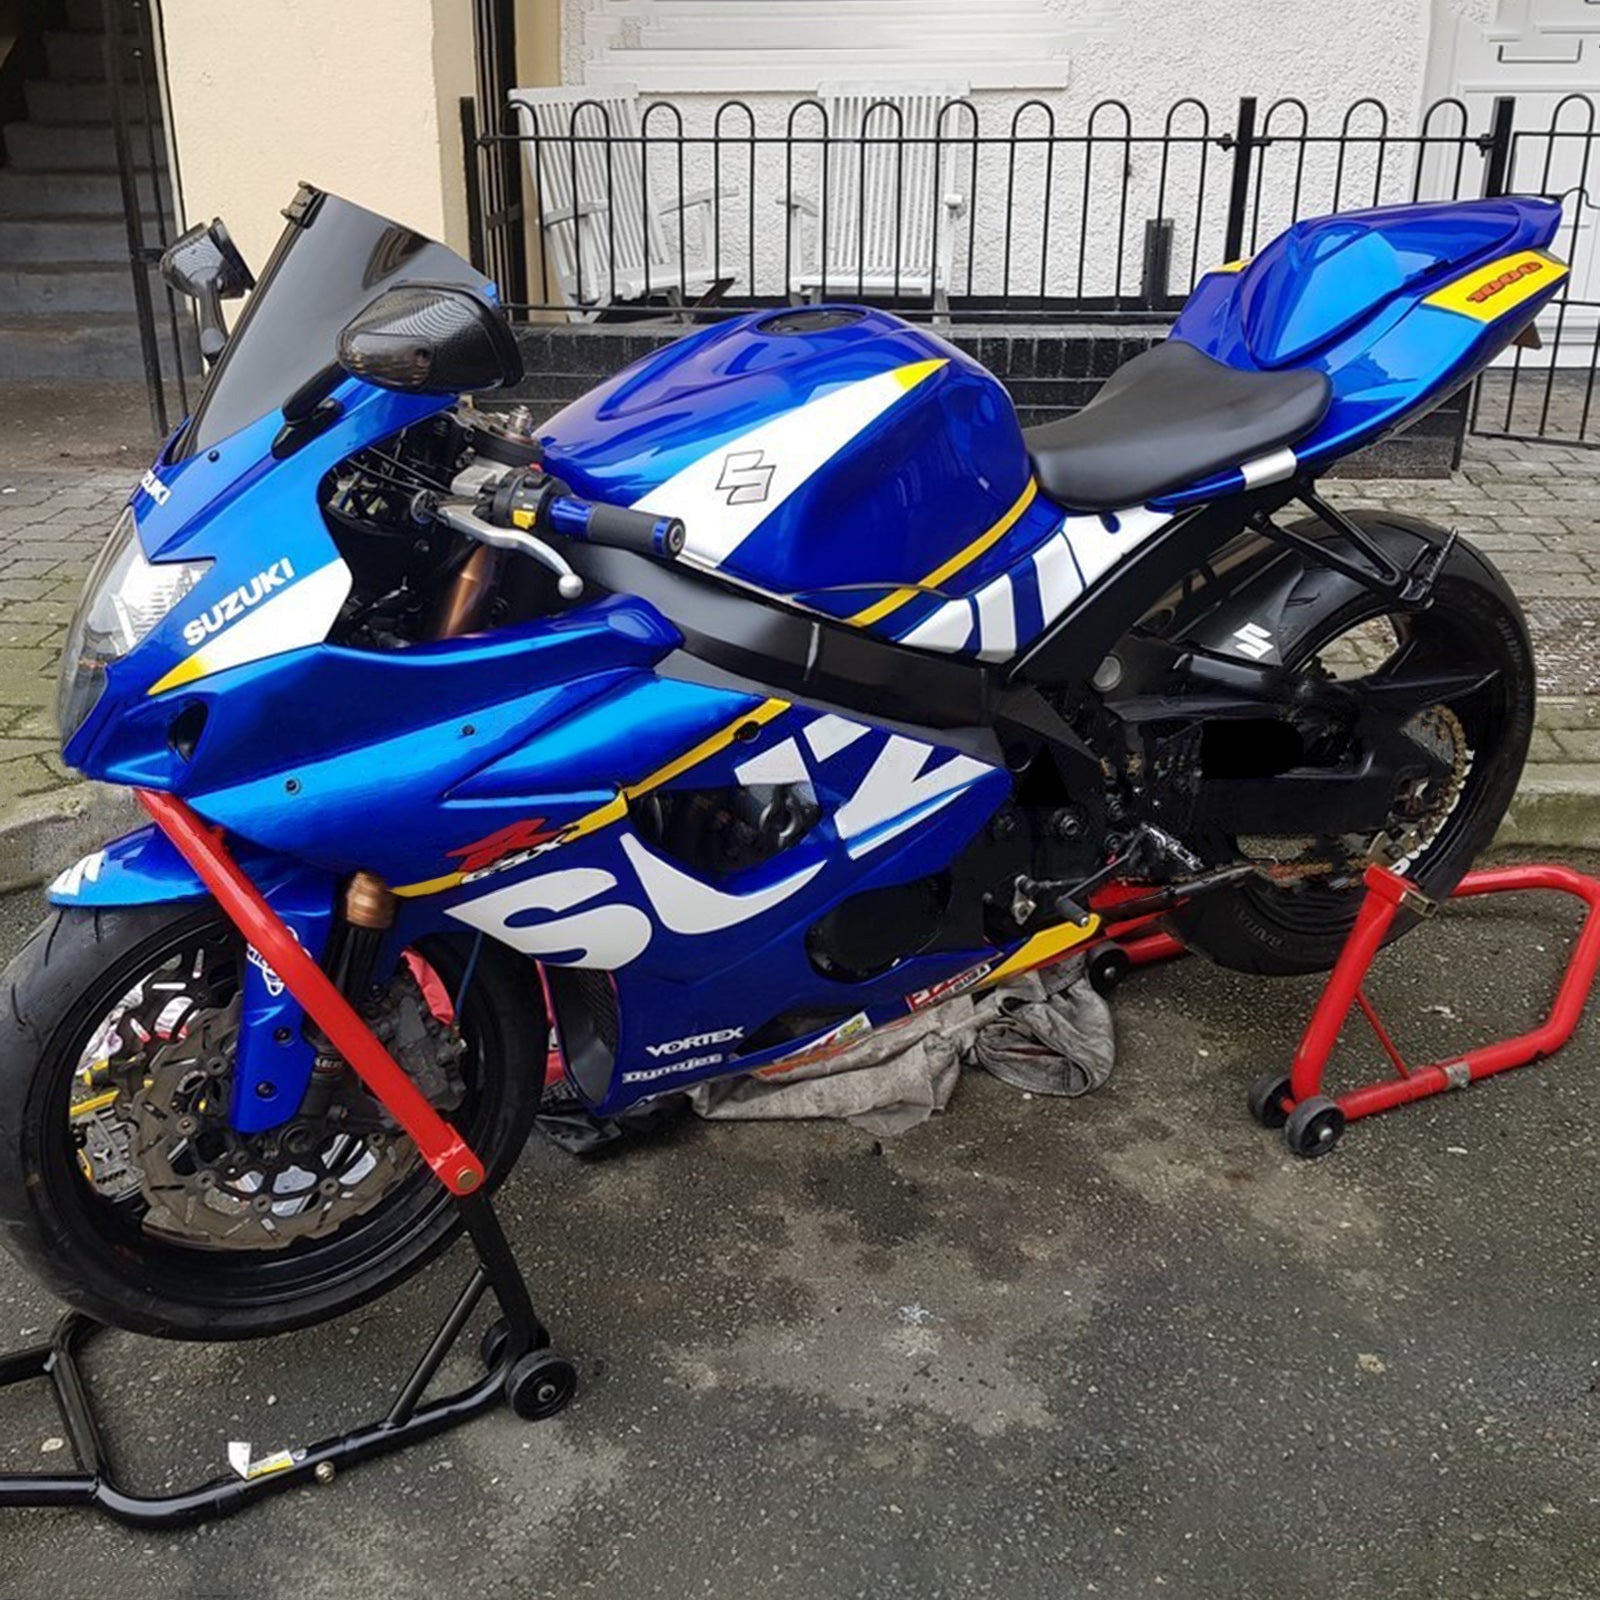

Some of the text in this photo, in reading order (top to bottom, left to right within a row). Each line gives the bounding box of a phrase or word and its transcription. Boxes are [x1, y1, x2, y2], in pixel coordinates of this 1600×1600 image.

[1465, 261, 1543, 304] 1000
[183, 557, 296, 647] SUZUKI
[645, 1026, 744, 1057] VORTEX
